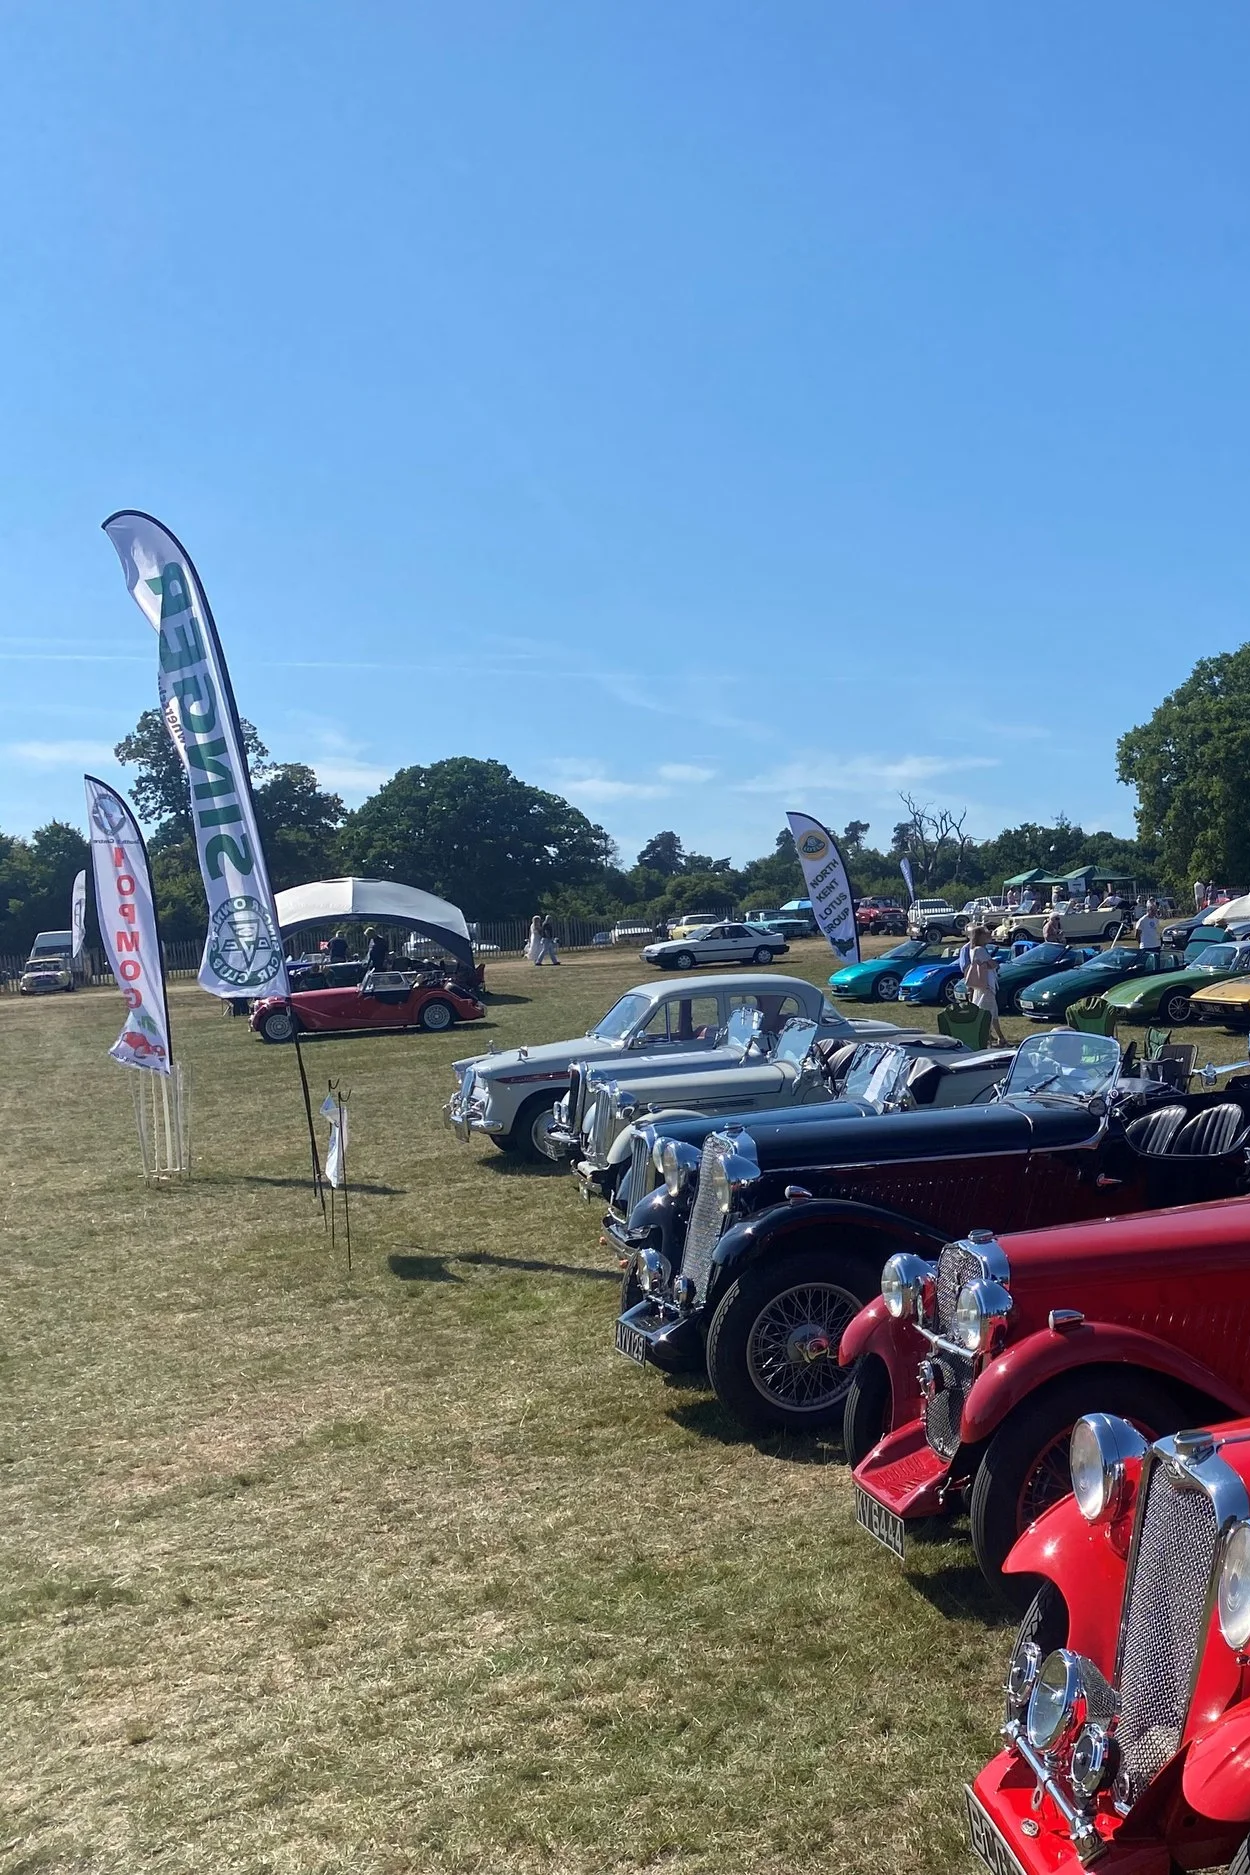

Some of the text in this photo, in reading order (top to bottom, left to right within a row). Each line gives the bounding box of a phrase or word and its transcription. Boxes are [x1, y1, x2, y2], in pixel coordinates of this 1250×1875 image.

[810, 859, 840, 890] NORTH
[815, 878, 840, 903] KENT
[819, 892, 848, 921] LOTUS
[823, 907, 850, 935] GROUP
